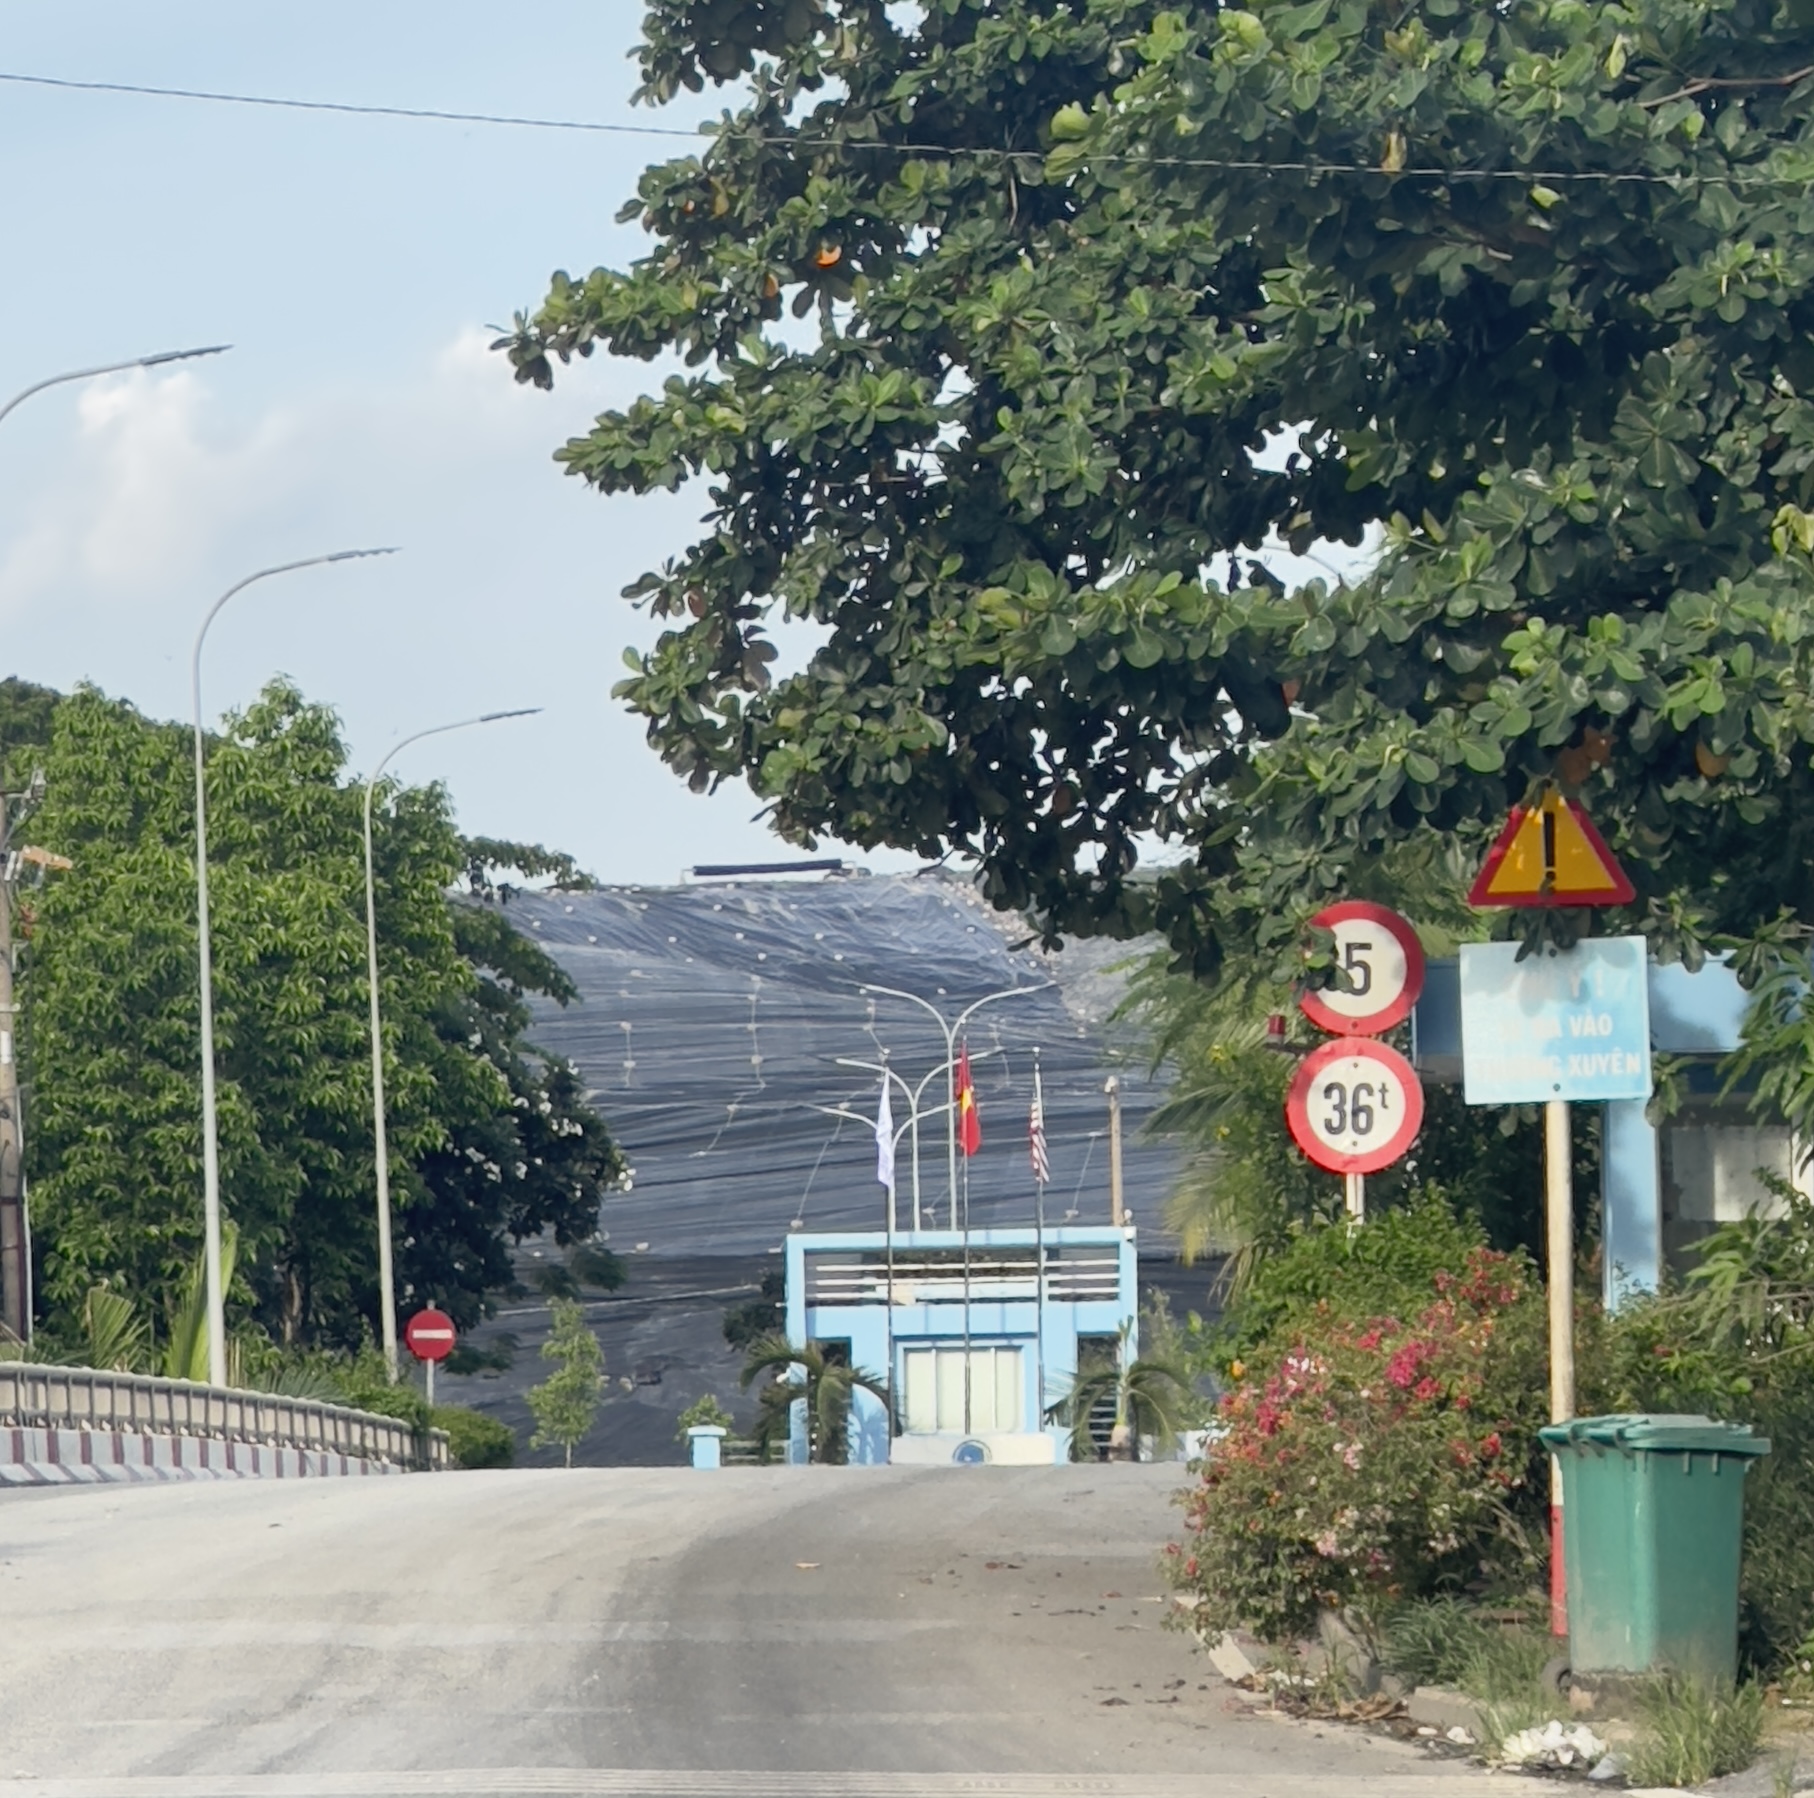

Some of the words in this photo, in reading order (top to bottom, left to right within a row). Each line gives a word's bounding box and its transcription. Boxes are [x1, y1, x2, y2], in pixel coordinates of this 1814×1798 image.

[1345, 942, 1373, 997] 5
[1569, 1006, 1613, 1038] VÀO
[1568, 1047, 1641, 1076] XUYÊN
